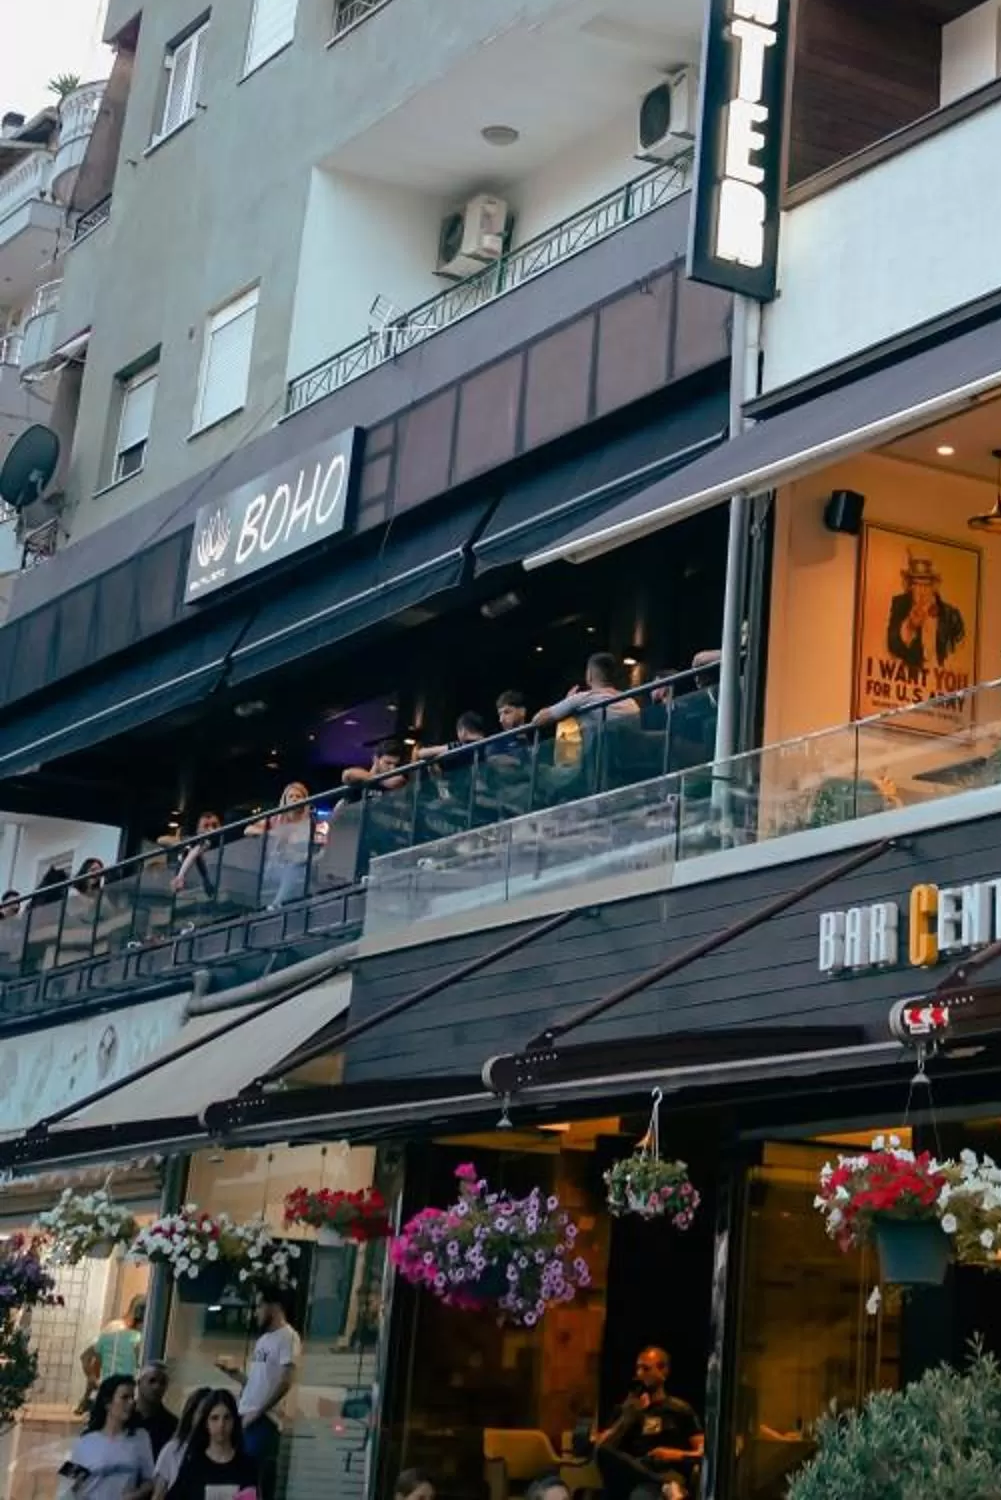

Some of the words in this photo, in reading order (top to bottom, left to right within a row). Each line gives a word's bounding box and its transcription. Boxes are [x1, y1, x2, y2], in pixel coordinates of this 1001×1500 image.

[235, 454, 346, 565] BOHO
[865, 679, 891, 698] FOR
[866, 656, 873, 677] I
[879, 659, 929, 687] WANT
[934, 667, 969, 692] YOU
[819, 901, 898, 973] BAR
